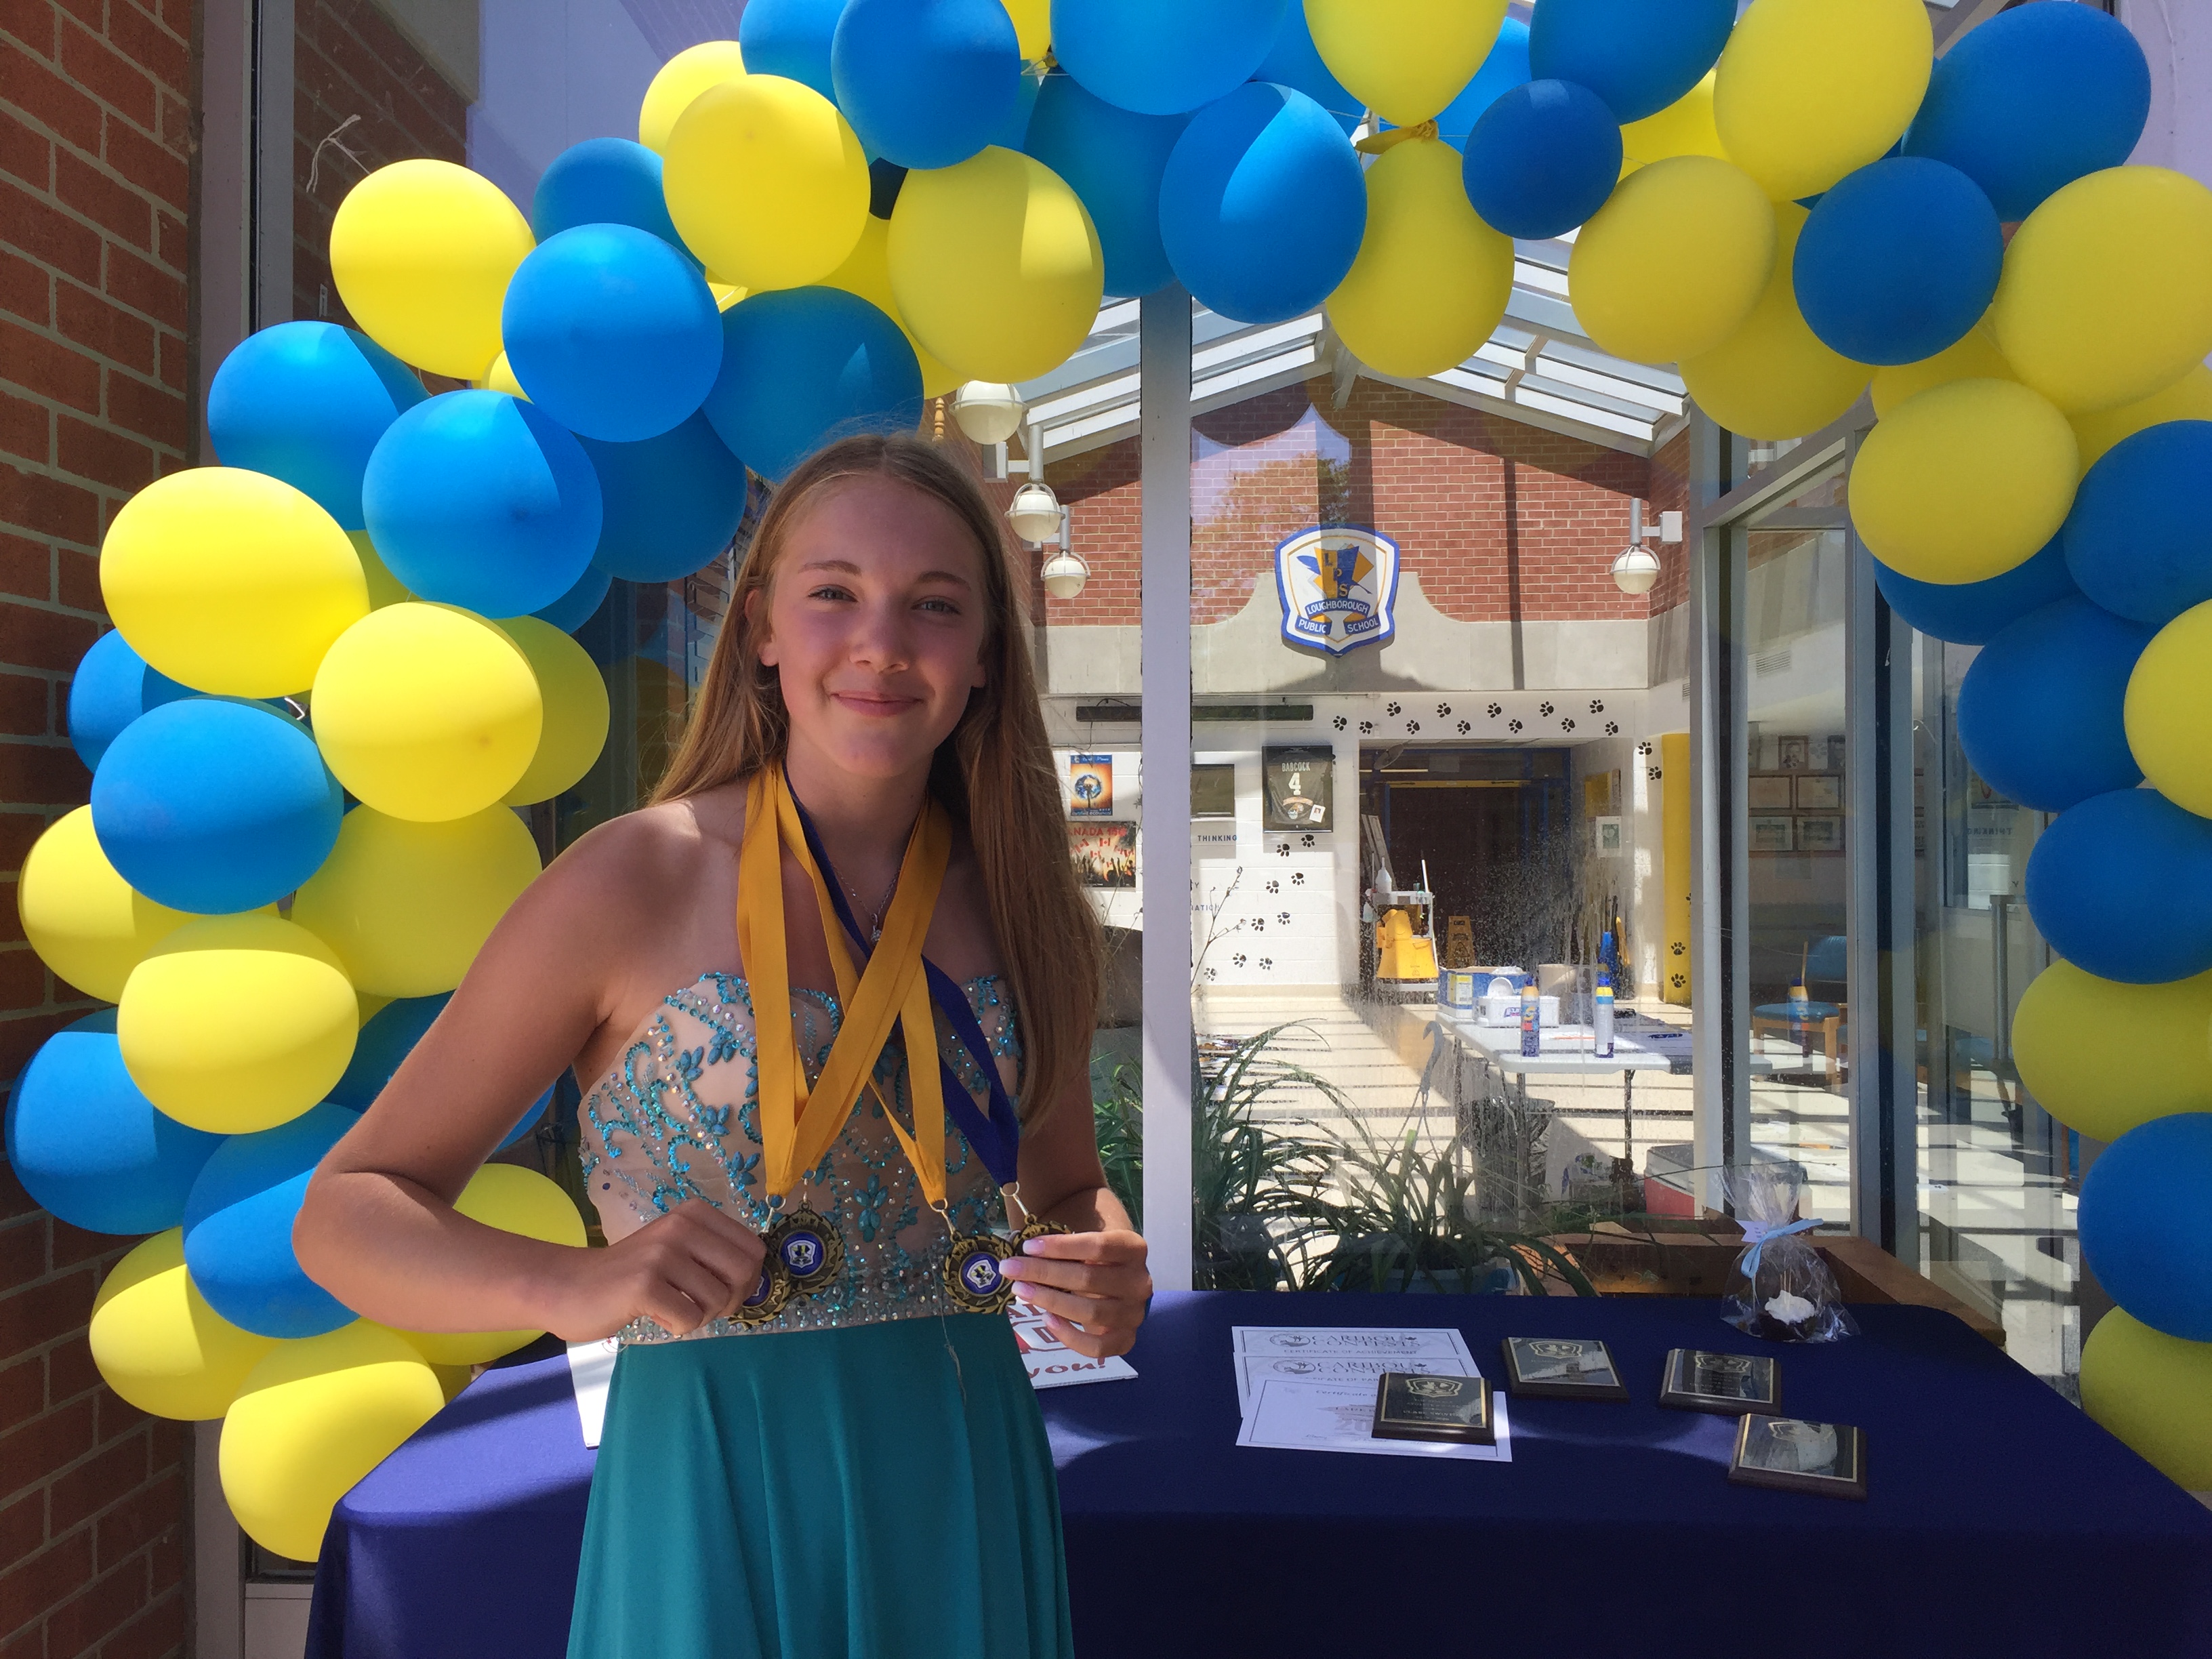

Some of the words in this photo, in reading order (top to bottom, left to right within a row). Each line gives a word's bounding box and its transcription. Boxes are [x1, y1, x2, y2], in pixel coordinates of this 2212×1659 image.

[1307, 600, 1369, 614] LOUGHBOROUGH
[1298, 618, 1326, 634] PUBLIC
[1347, 617, 1379, 634] SCHOOL
[1282, 762, 1310, 772] BABCOCK
[1288, 772, 1301, 796] 4
